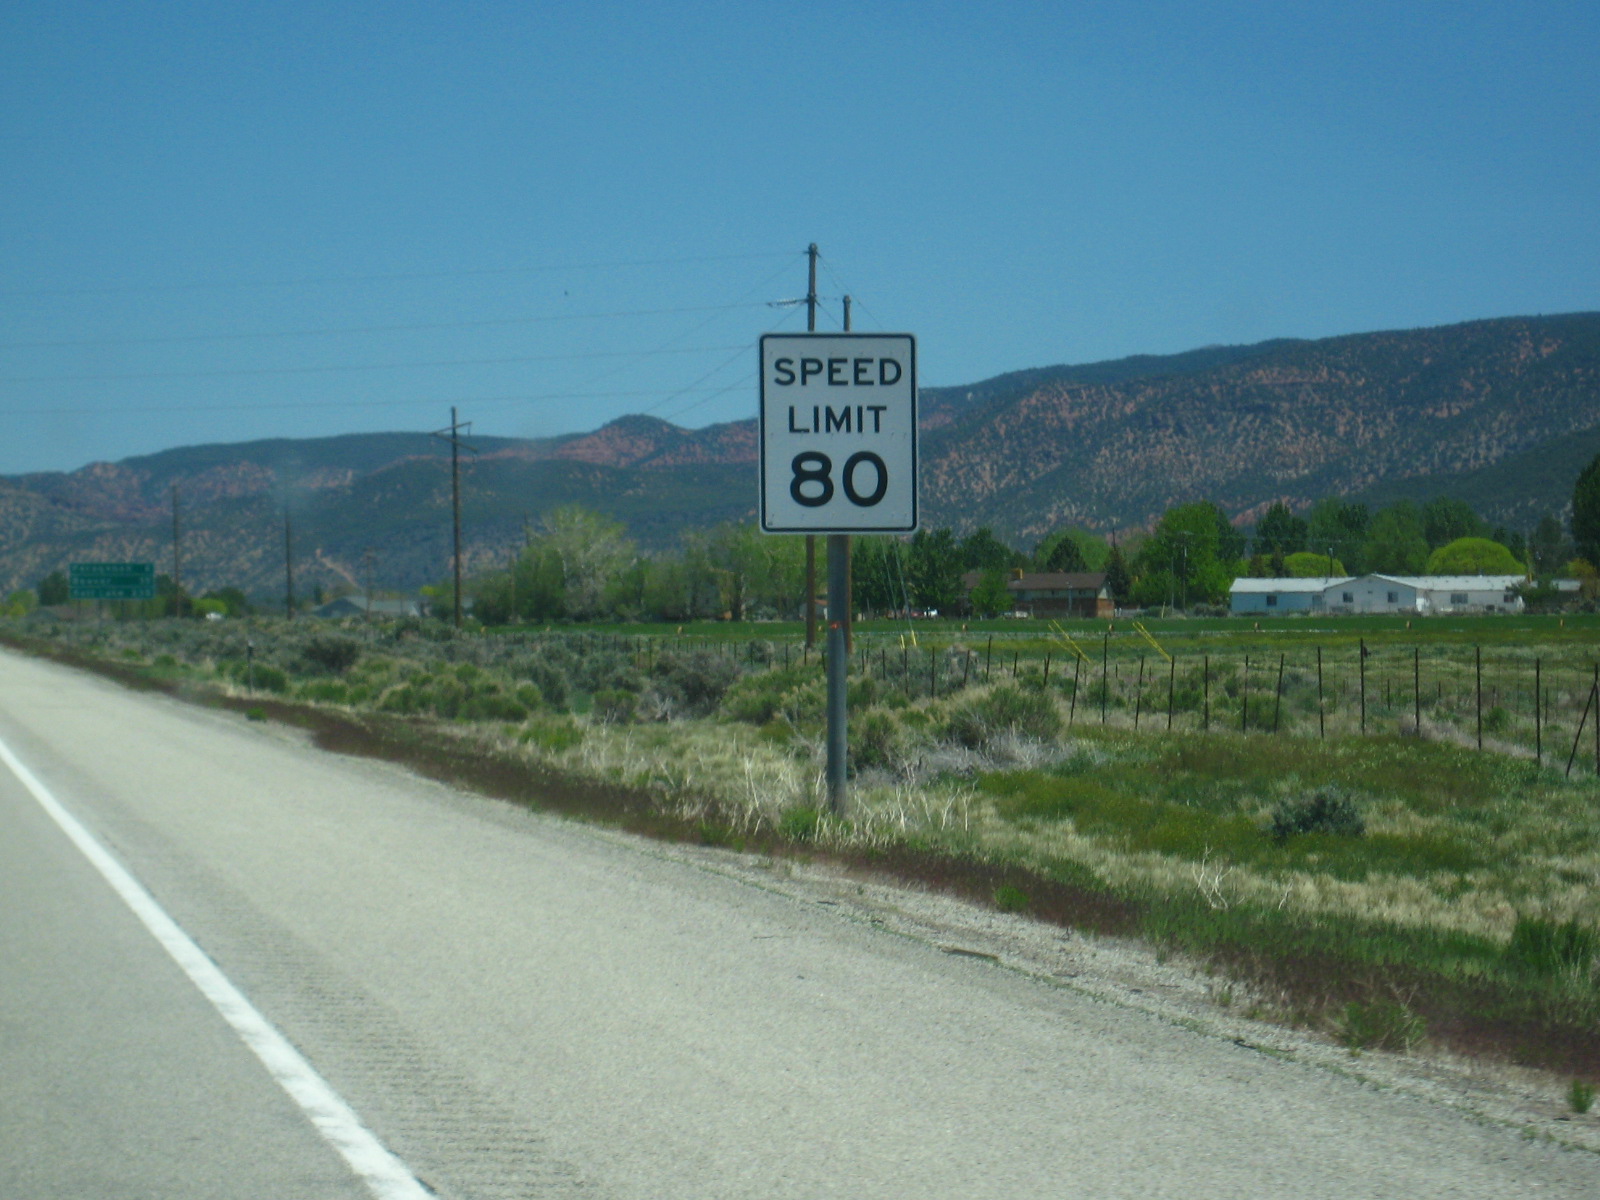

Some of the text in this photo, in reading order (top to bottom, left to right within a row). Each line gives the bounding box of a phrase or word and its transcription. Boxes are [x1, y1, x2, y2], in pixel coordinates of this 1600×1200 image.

[773, 356, 903, 388] SPEED
[788, 404, 888, 435] LIMIT
[789, 449, 889, 509] 80
